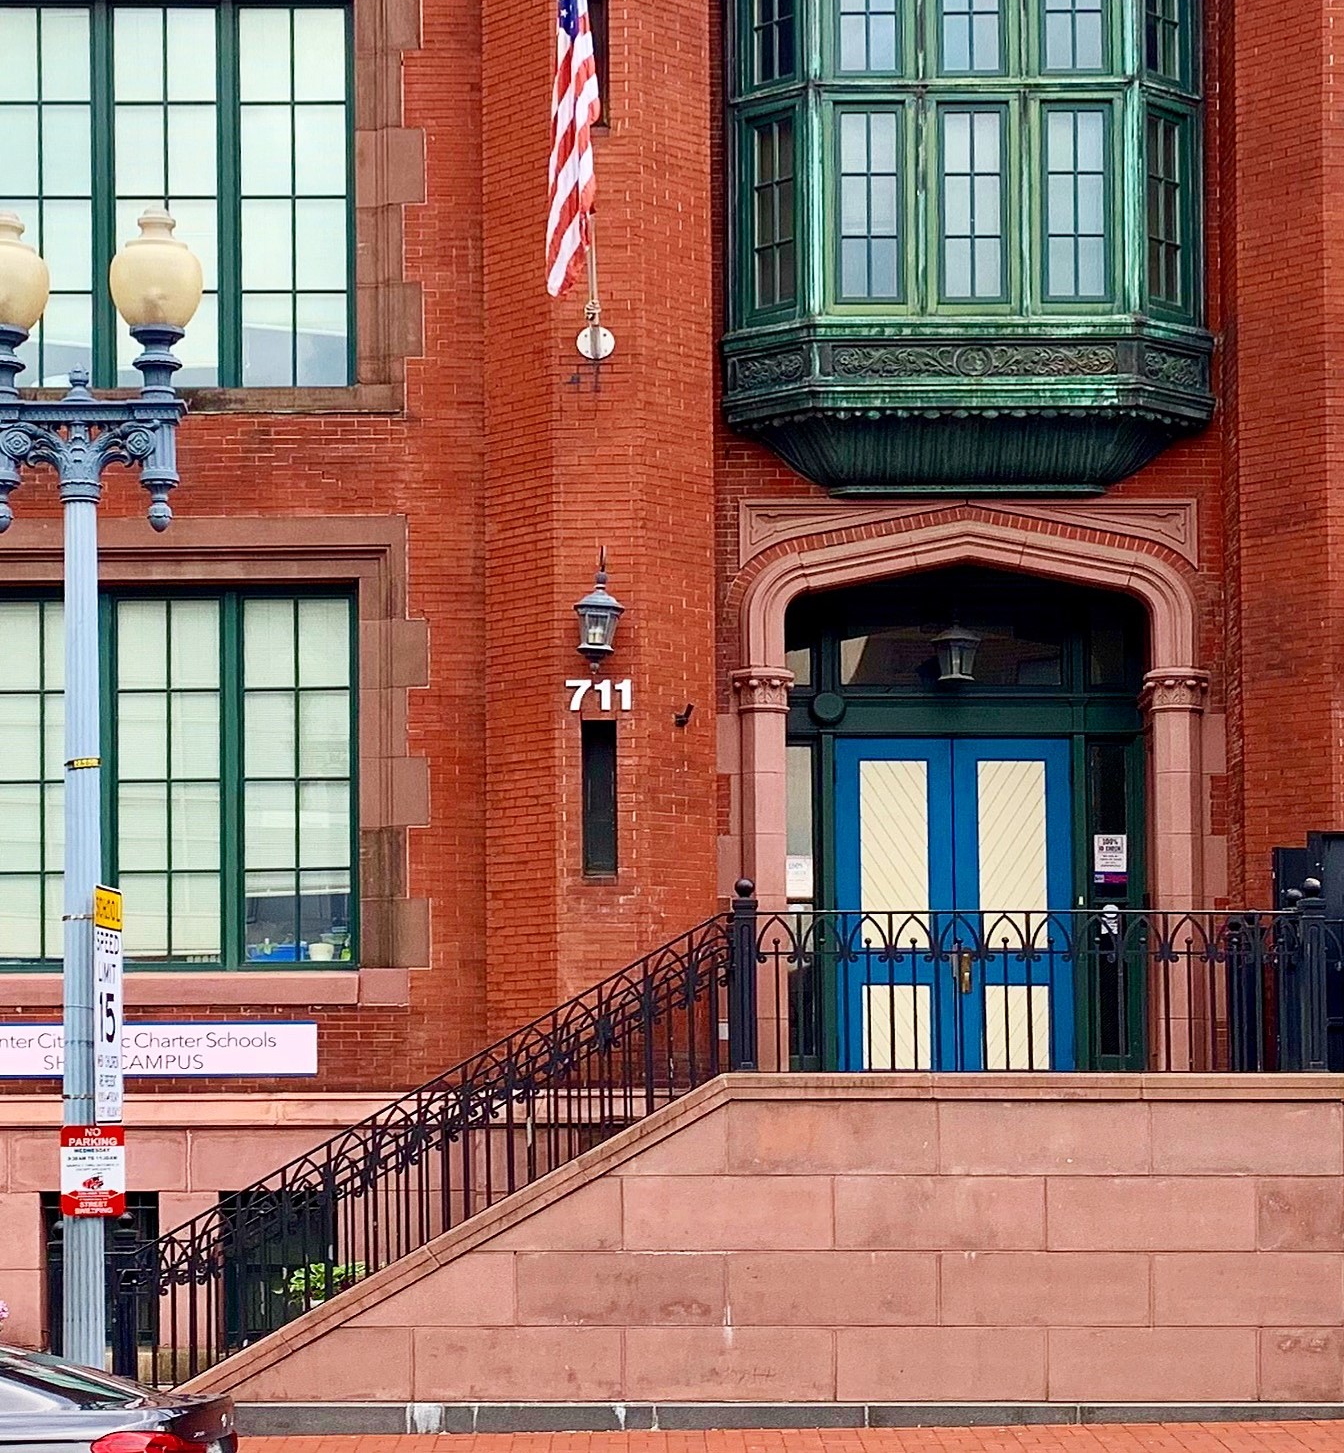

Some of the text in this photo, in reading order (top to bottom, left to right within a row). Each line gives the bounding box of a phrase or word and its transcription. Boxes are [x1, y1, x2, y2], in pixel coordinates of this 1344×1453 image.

[565, 679, 632, 711] 711
[97, 931, 119, 955] SPEED
[98, 961, 116, 984] LIMIT
[99, 992, 116, 1043] 15
[37, 1033, 64, 1049] Cit
[134, 1032, 202, 1048] Charter
[206, 1031, 277, 1048] Schools
[68, 1137, 118, 1146] PARKING
[84, 1128, 101, 1137] NO
